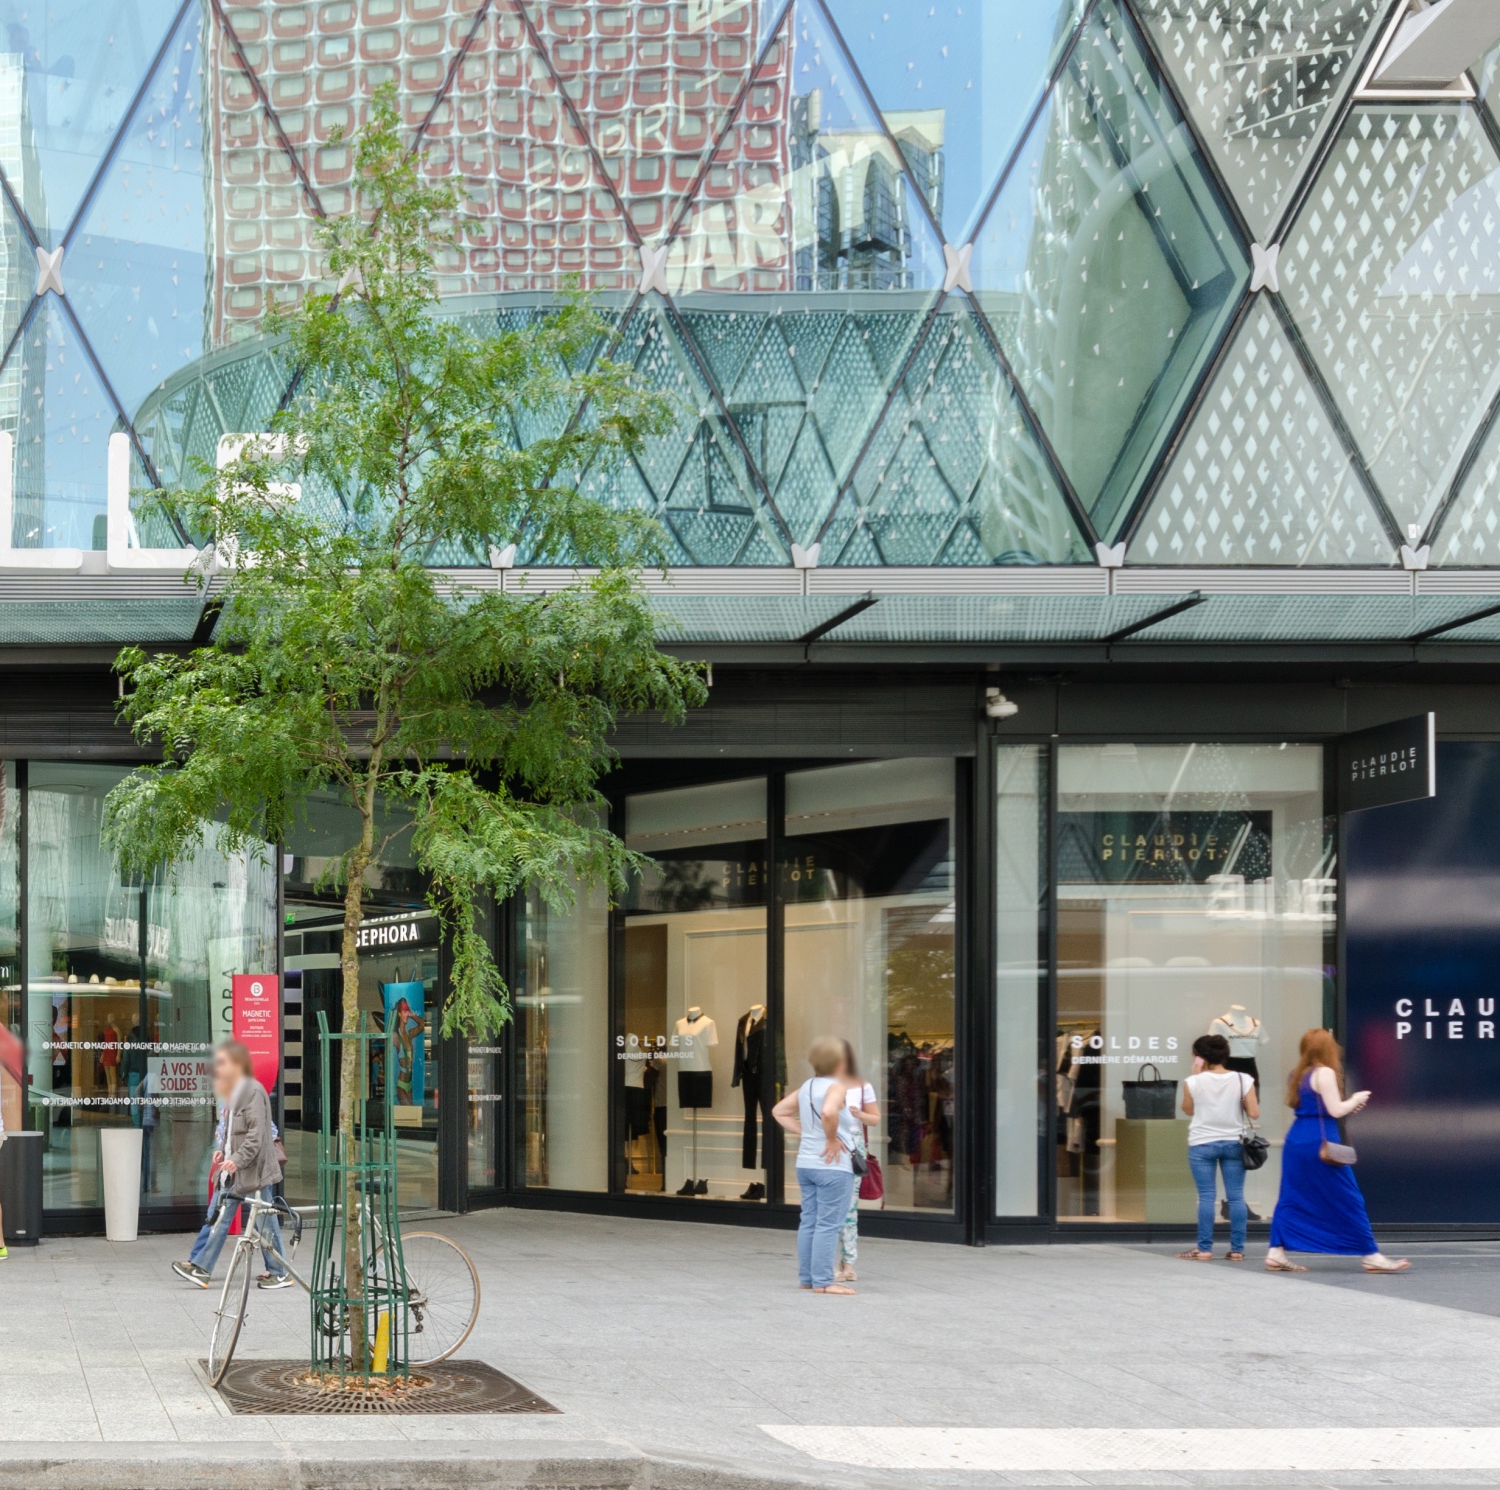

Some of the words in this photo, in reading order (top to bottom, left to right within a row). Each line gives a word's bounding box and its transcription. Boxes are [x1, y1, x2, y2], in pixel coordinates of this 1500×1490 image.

[1352, 747, 1417, 771] CLAUDIE
[1352, 759, 1417, 782] PIERLOT
[1102, 834, 1218, 847] CLAUDIE
[1102, 848, 1217, 861] PIERLOT
[722, 855, 815, 875] CLAIE
[722, 869, 815, 888] PIEOT
[242, 1010, 271, 1018] MAGNETIC
[1395, 998, 1495, 1017] CLAU
[1397, 1021, 1495, 1039] PIER
[50, 1042, 84, 1050] MAGNETIC
[91, 1042, 123, 1050] MAGNETIC
[130, 1042, 163, 1050] MAGNETIC
[169, 1043, 200, 1051] MAGNETIC
[616, 1035, 694, 1047] SOLDES
[1070, 1035, 1178, 1049] SOLDES
[617, 1051, 652, 1060] DERNIÈRE
[653, 1050, 694, 1059] DÉMARQUE
[1071, 1054, 1121, 1065] DERNIÈRE
[1122, 1053, 1178, 1064] DÉMARQUE
[161, 1060, 168, 1076] À
[171, 1063, 193, 1076] VOS
[160, 1077, 197, 1091] SOLDES
